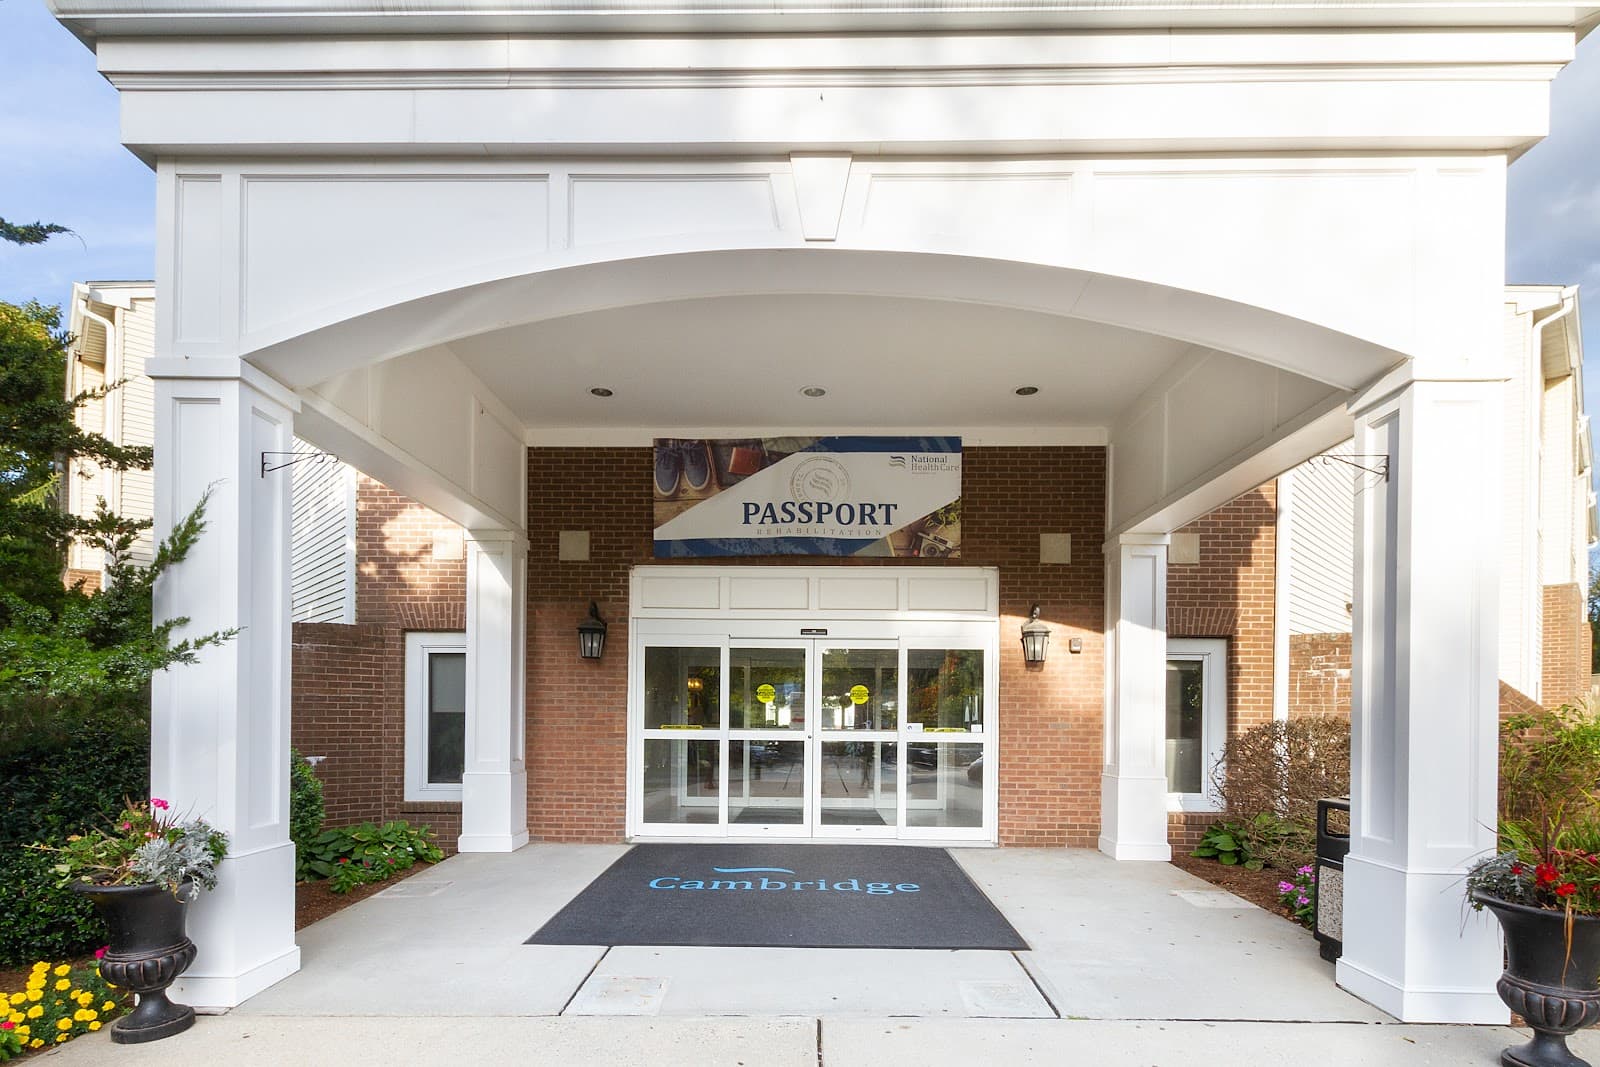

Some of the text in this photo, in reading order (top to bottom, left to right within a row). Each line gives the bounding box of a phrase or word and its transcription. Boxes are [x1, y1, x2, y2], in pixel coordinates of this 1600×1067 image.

[911, 455, 948, 463] National
[742, 501, 898, 526] PASSPORT
[756, 527, 882, 537] REHABILITATION
[648, 876, 922, 896] Cambridge
